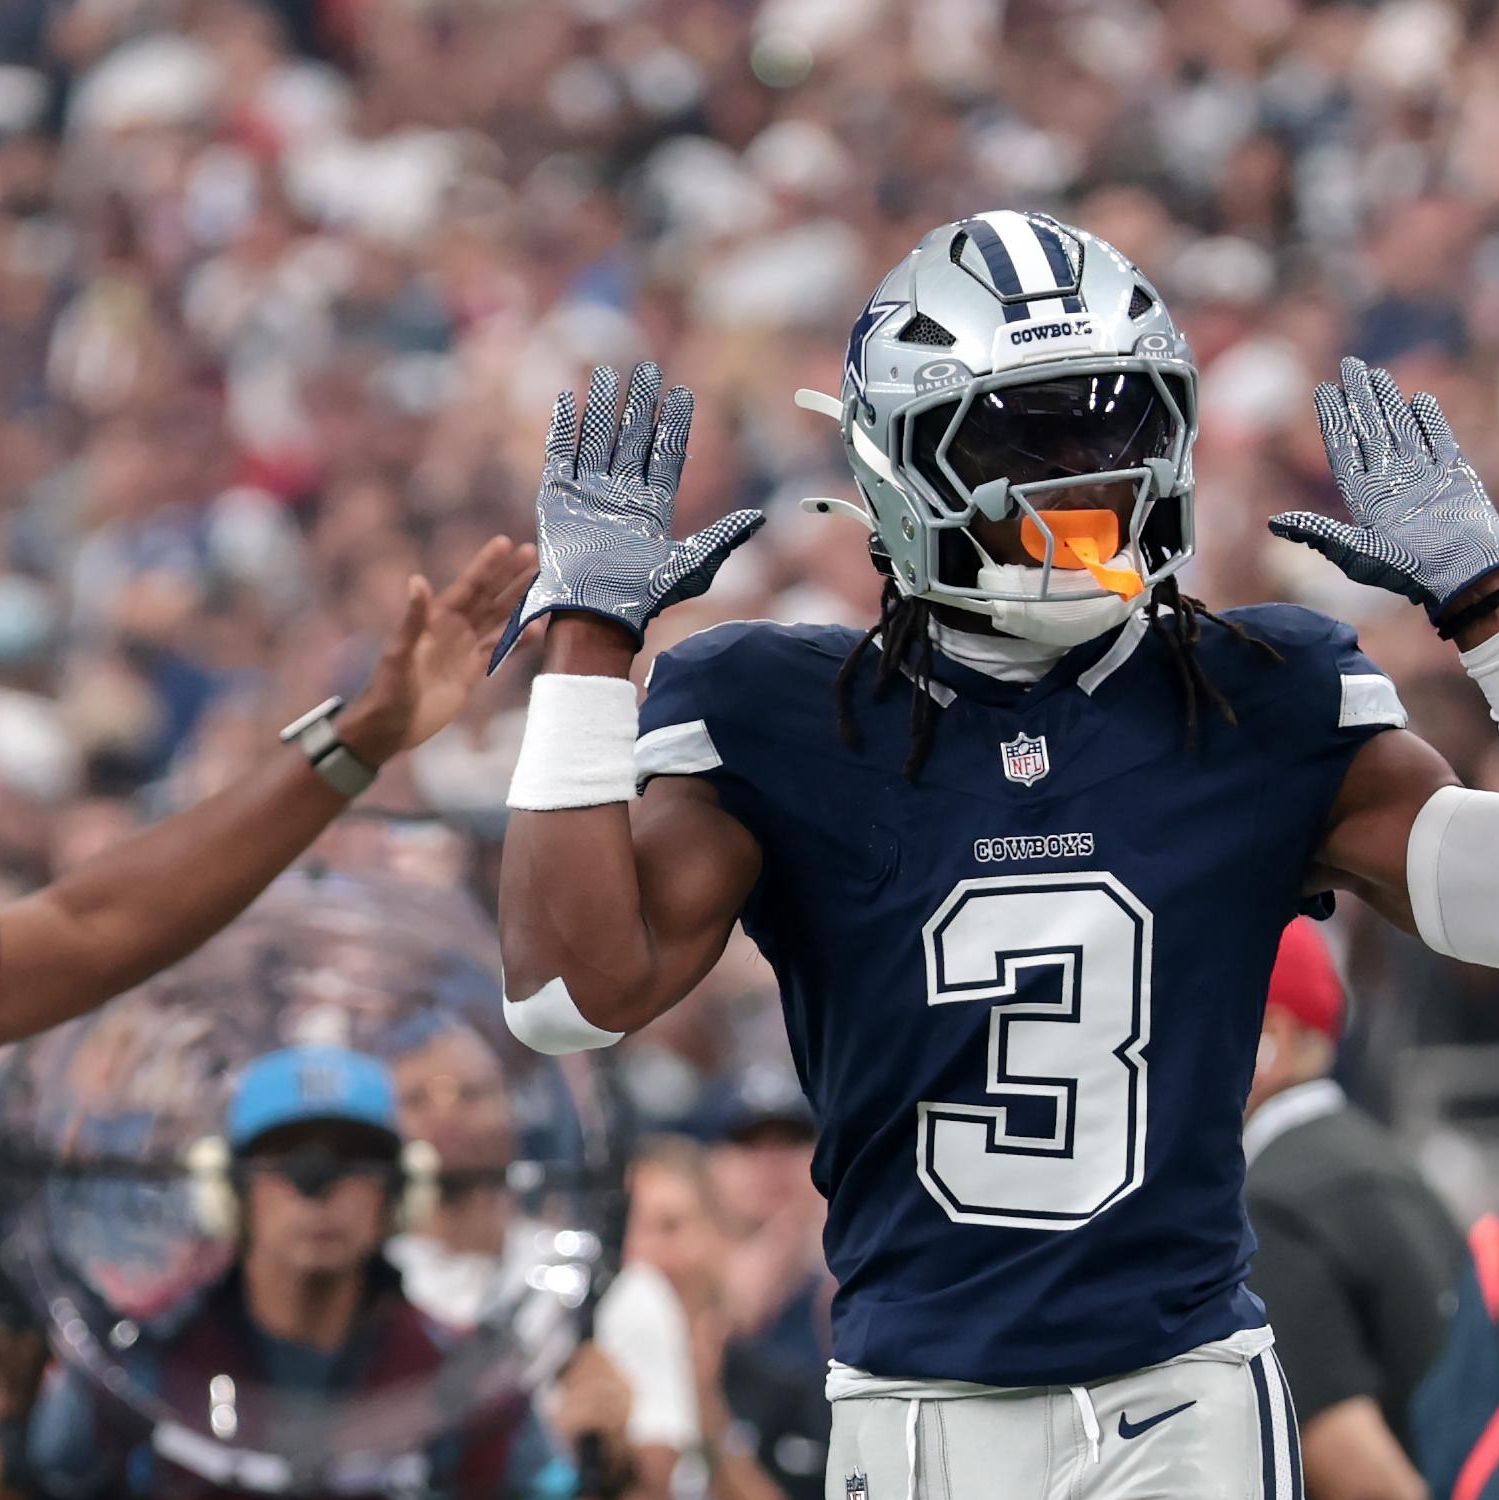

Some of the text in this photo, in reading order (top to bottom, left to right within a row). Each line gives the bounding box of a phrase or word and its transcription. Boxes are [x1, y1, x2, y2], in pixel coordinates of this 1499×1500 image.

[916, 375, 967, 392] OAKLEY
[1010, 755, 1044, 776] NFL
[974, 833, 1094, 862] COWBOYS
[916, 870, 1154, 1231] 3
